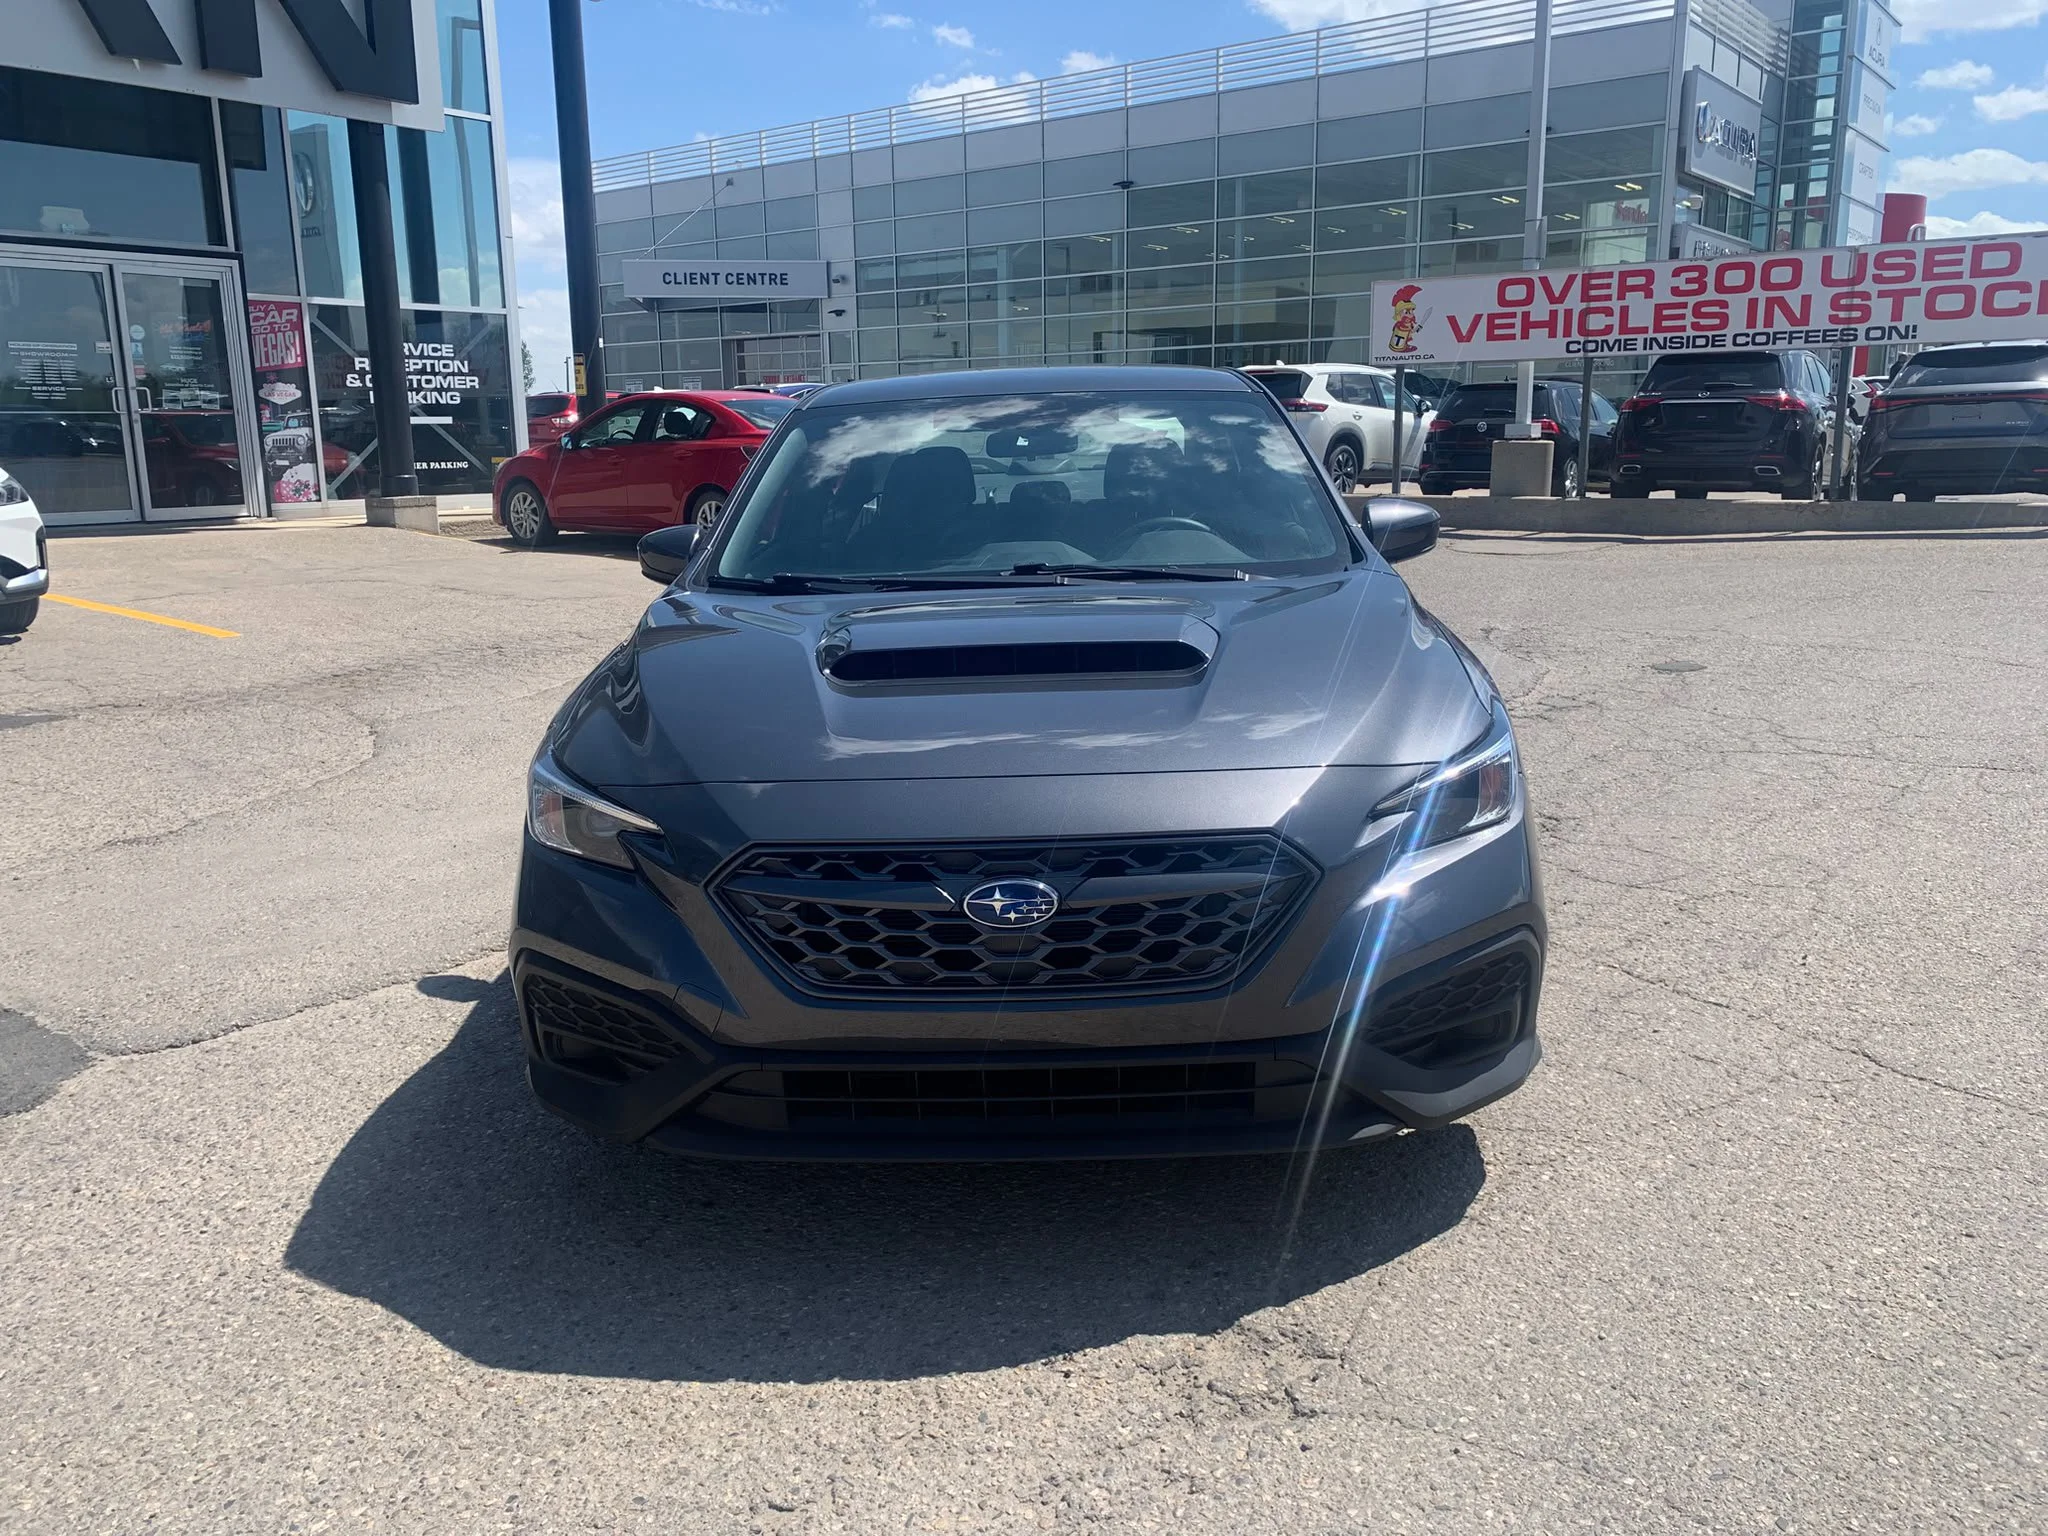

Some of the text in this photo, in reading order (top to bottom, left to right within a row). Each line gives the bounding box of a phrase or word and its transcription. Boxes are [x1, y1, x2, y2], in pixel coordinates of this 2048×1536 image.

[1710, 115, 1757, 161] ACURA
[661, 272, 790, 286] CLIENT CENTRE
[1496, 241, 2023, 309] OVER 300 USED
[267, 303, 276, 311] A
[249, 308, 299, 327] CAR
[1446, 298, 1731, 344] VEHICLES
[1745, 293, 1813, 330] IN
[251, 322, 291, 335] GO TO
[1564, 324, 1919, 354] COME INSIDE COFFEES ON!
[252, 330, 302, 369] VEGAS!
[1374, 353, 1436, 363] TITANAUTO.CA
[354, 357, 469, 374] RPTION
[345, 373, 363, 388] &
[429, 461, 470, 470] PARKING
